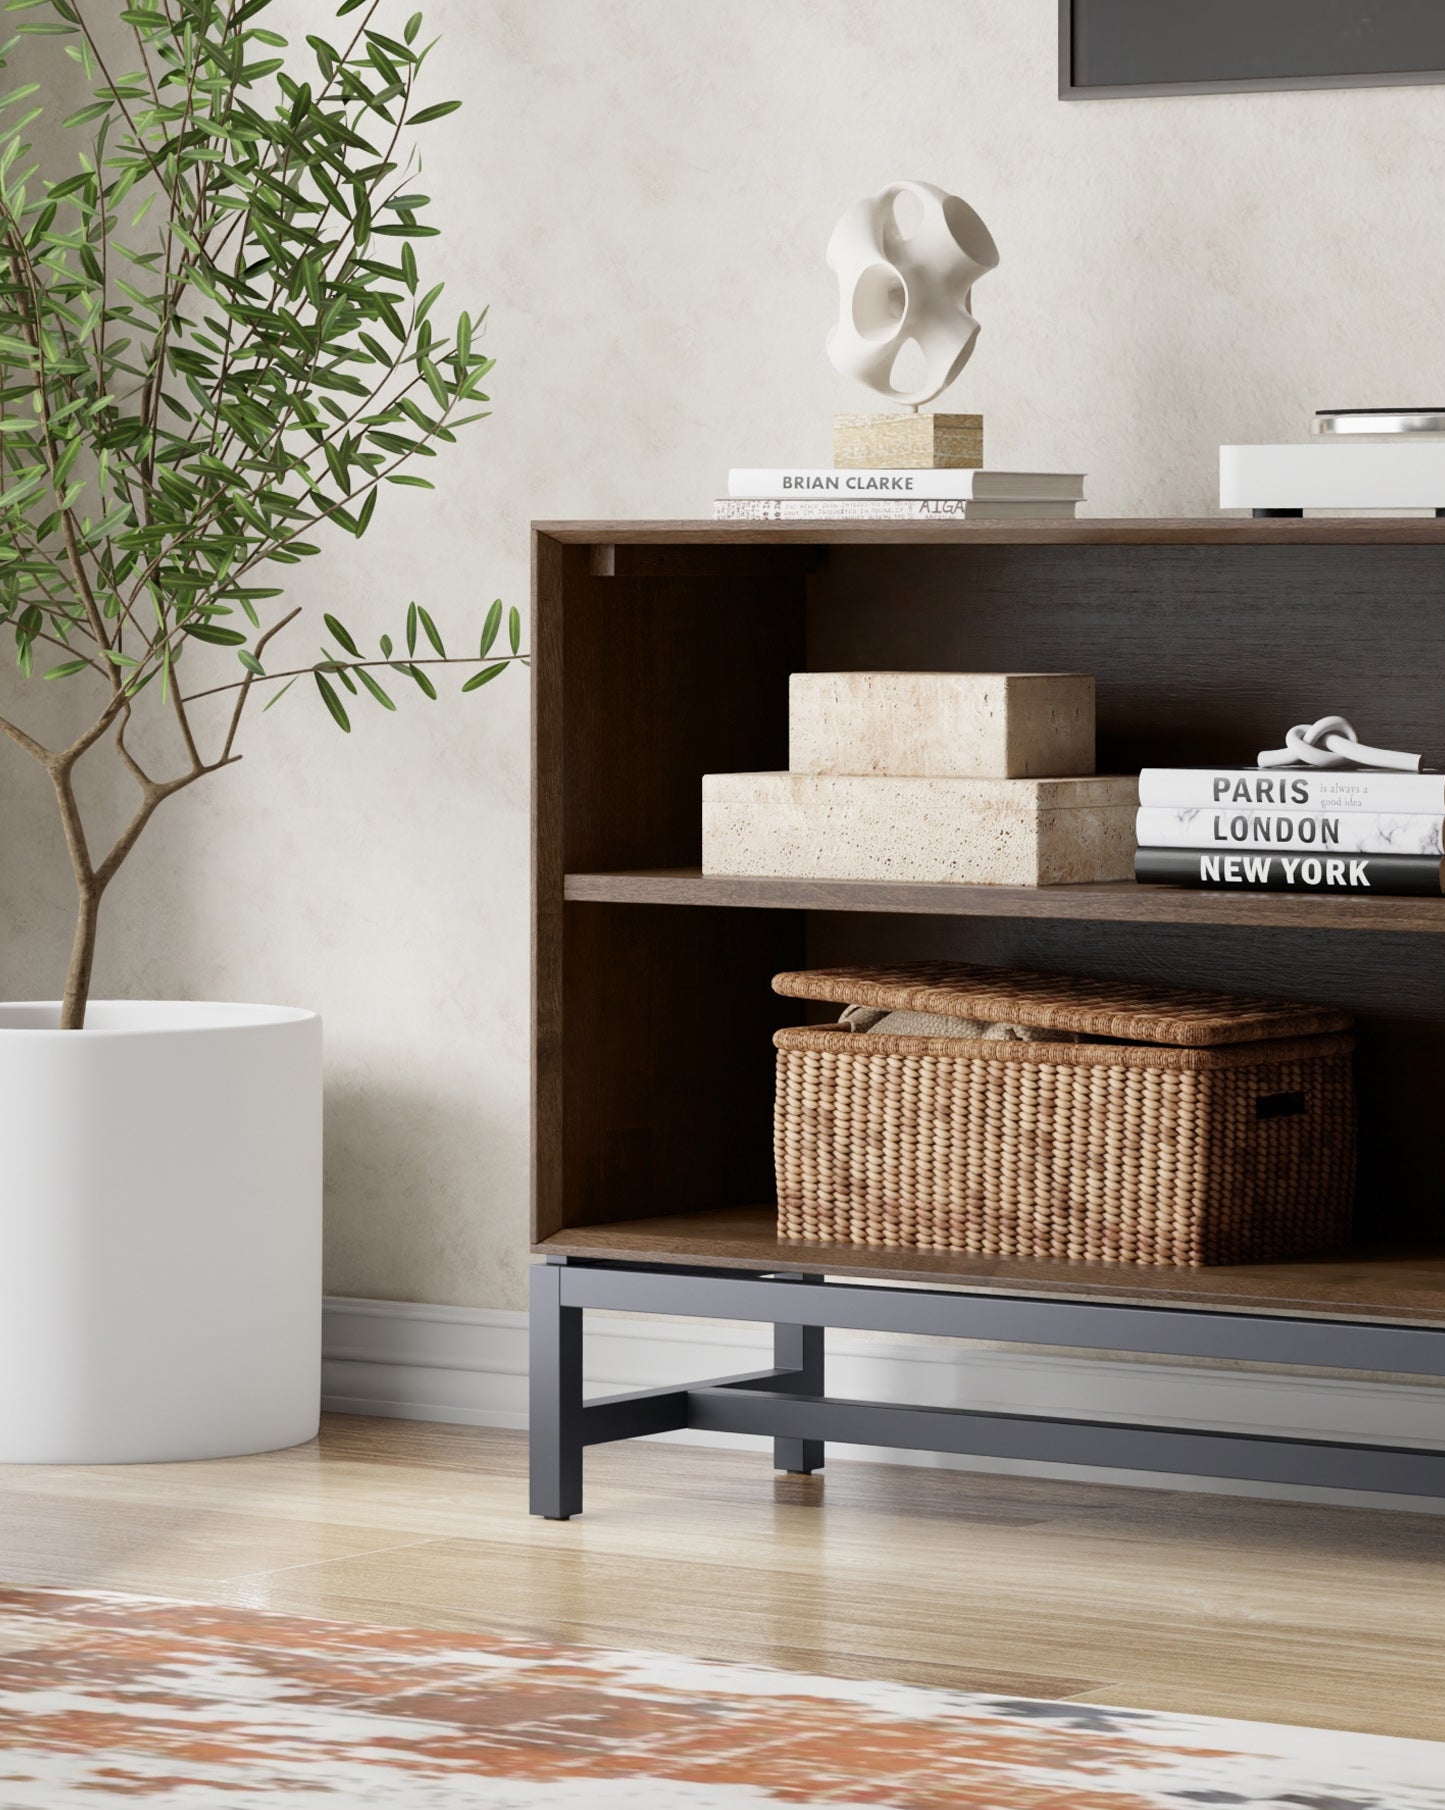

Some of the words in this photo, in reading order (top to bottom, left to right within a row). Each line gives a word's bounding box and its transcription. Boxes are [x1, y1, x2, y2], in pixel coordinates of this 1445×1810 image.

[782, 476, 839, 491] BRIAN
[846, 476, 914, 491] CLARKE
[919, 500, 965, 515] AIGA
[1213, 777, 1309, 804] PARIS
[1320, 784, 1327, 794] is
[1330, 783, 1359, 796] always
[1363, 786, 1368, 794] a
[1320, 796, 1342, 808] good
[1344, 797, 1362, 807] idea
[1213, 815, 1340, 844] LONDON
[1200, 856, 1271, 884] NEW
[1281, 859, 1371, 887] YORK
